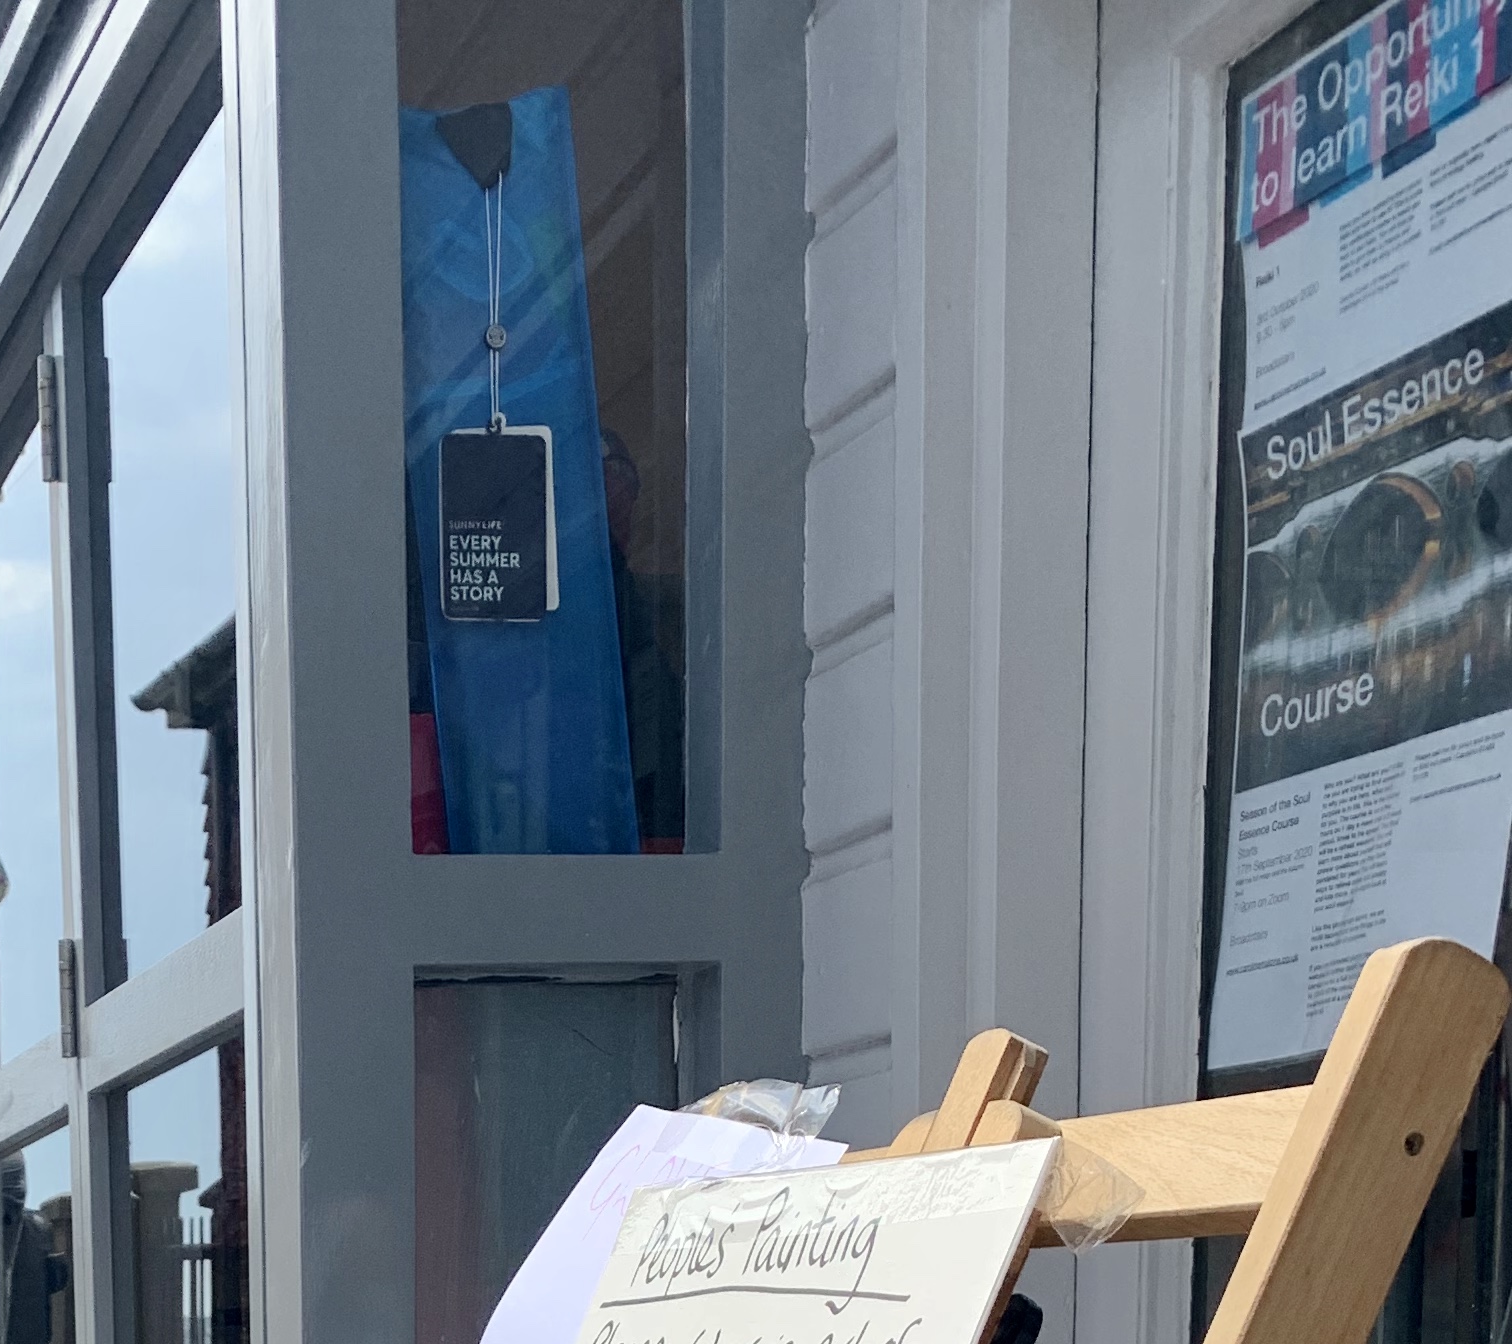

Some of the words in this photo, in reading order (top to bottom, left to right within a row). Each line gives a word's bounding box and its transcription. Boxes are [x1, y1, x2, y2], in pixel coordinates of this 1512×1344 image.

[1251, 171, 1279, 213] to
[1291, 114, 1367, 210] learn
[1379, 42, 1460, 138] Reiki
[1471, 26, 1485, 75] 1
[1251, 93, 1308, 154] The
[1266, 409, 1332, 481] Soul
[1343, 346, 1486, 447] Essence
[449, 534, 502, 551] EVERY
[449, 552, 521, 568] SUMMER
[450, 569, 484, 585] HAS
[487, 569, 499, 584] A
[450, 585, 505, 602] STORY
[1259, 670, 1375, 738] Course
[1292, 791, 1312, 807] Soul
[1238, 825, 1271, 842] Essence
[1271, 816, 1300, 832] Course
[742, 1187, 882, 1314] Painting
